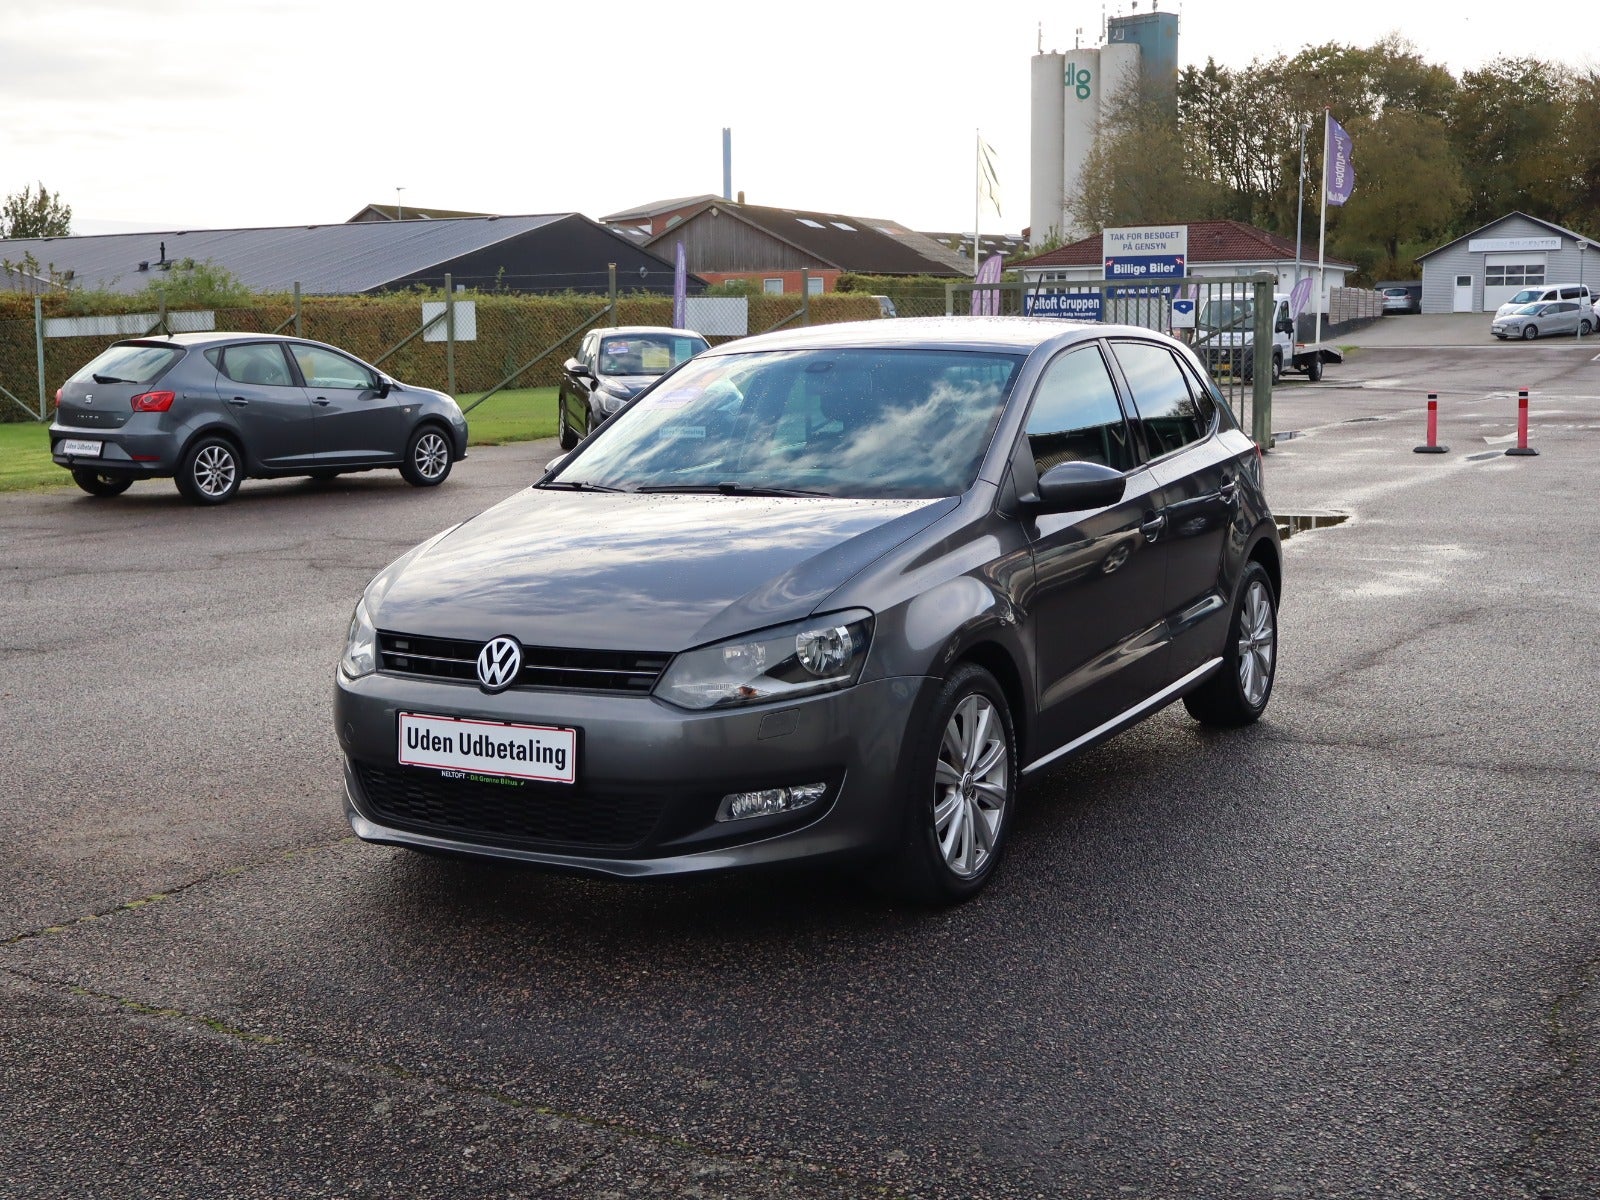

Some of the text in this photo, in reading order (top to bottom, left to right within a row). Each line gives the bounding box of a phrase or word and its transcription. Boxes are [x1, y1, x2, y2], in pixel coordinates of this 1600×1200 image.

[1064, 62, 1091, 100] dlg
[1110, 233, 1125, 241] TAK
[1144, 231, 1180, 239] BESØGET
[1135, 242, 1166, 250] GENSYN
[1113, 262, 1175, 275] Billige Biler
[1116, 286, 1170, 295] www.elof.d
[1026, 295, 1099, 311] Neltoft Gruppen
[407, 726, 566, 771] Uden Udbetaling
[441, 770, 466, 779] NELTOFT
